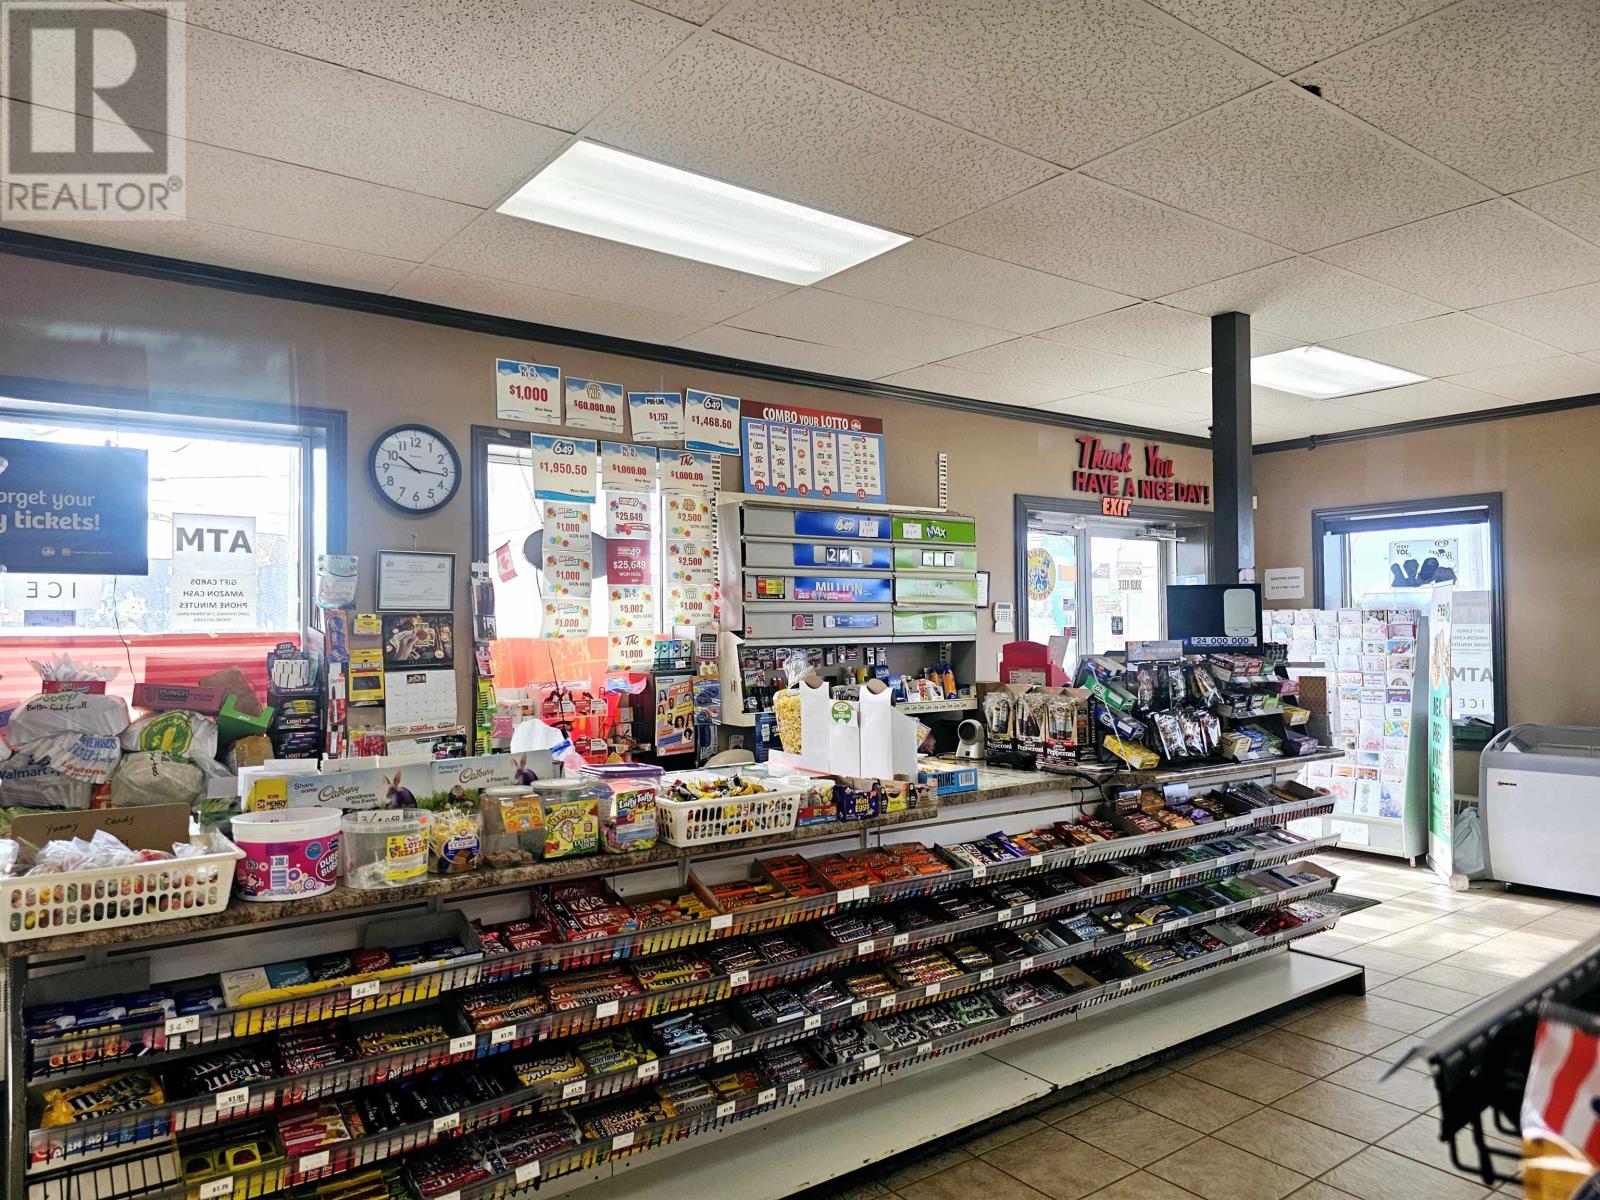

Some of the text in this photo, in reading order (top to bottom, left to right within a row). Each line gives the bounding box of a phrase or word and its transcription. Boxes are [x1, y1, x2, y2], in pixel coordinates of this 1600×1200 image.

[509, 384, 549, 403] $1,000
[691, 415, 732, 430] $1,468.60
[762, 407, 849, 430] COMBO YOUR LOTTO
[399, 440, 407, 451] 11
[409, 437, 421, 448] 12
[428, 442, 432, 453] 1
[386, 450, 399, 461] 10
[437, 454, 444, 464] 2
[1075, 434, 1175, 479] Thank You
[382, 462, 390, 473] 9
[539, 461, 587, 476] $1,950.50
[386, 476, 394, 486] 8
[436, 480, 444, 490] 4
[399, 486, 407, 497] 7
[427, 488, 435, 499] 5
[1073, 471, 1210, 505] HAVE A NICE DAY!
[412, 491, 420, 502] 6
[52, 494, 96, 511] your
[1102, 496, 1133, 517] EXIT
[14, 510, 101, 532] tickets!
[677, 512, 702, 522] $2,500
[612, 561, 647, 571] $25,649
[678, 557, 703, 566] $2,500
[1046, 748, 1076, 758] Pepperoni
[459, 768, 494, 784] Cadbury
[294, 783, 314, 791] Share
[318, 784, 360, 802] Cadbury
[345, 792, 376, 802] goodness
[266, 799, 288, 807] HENRY
[618, 791, 655, 810] Laffy Taffy
